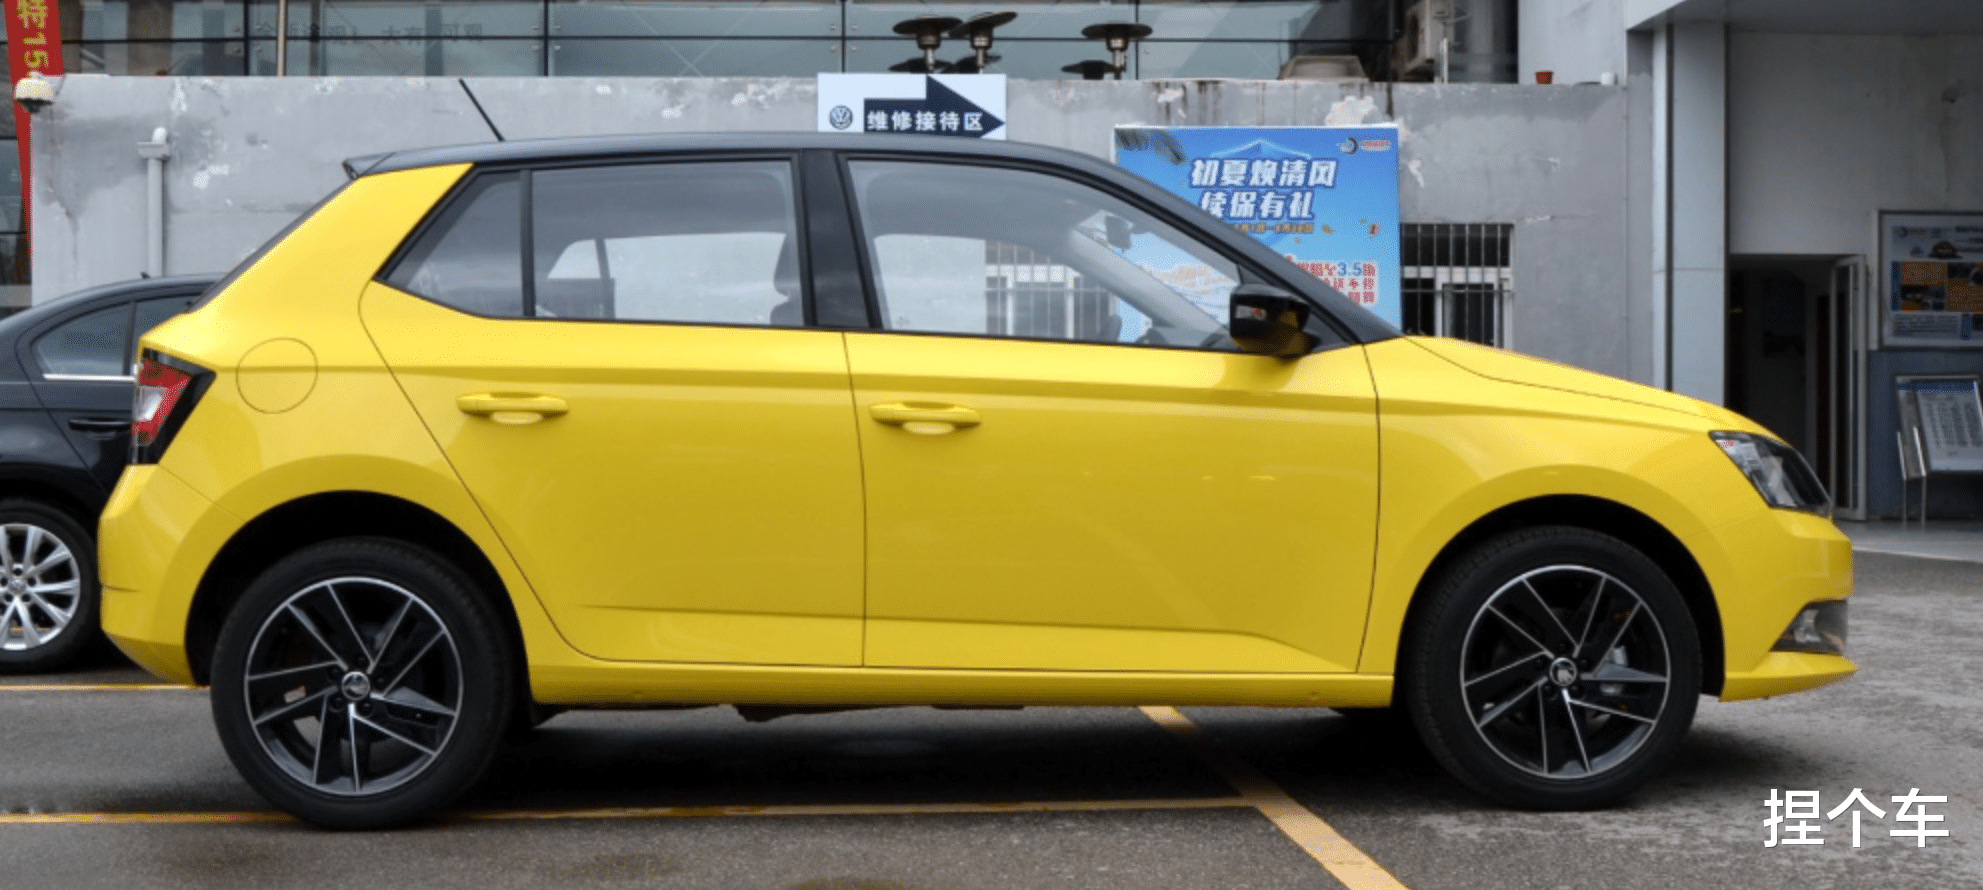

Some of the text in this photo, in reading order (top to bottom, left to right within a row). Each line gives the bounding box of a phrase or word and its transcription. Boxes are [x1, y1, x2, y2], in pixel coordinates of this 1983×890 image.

[867, 110, 984, 132] 维修接待区
[1191, 159, 1337, 187] 初夏焕清风
[1201, 191, 1314, 218] 续保有礼
